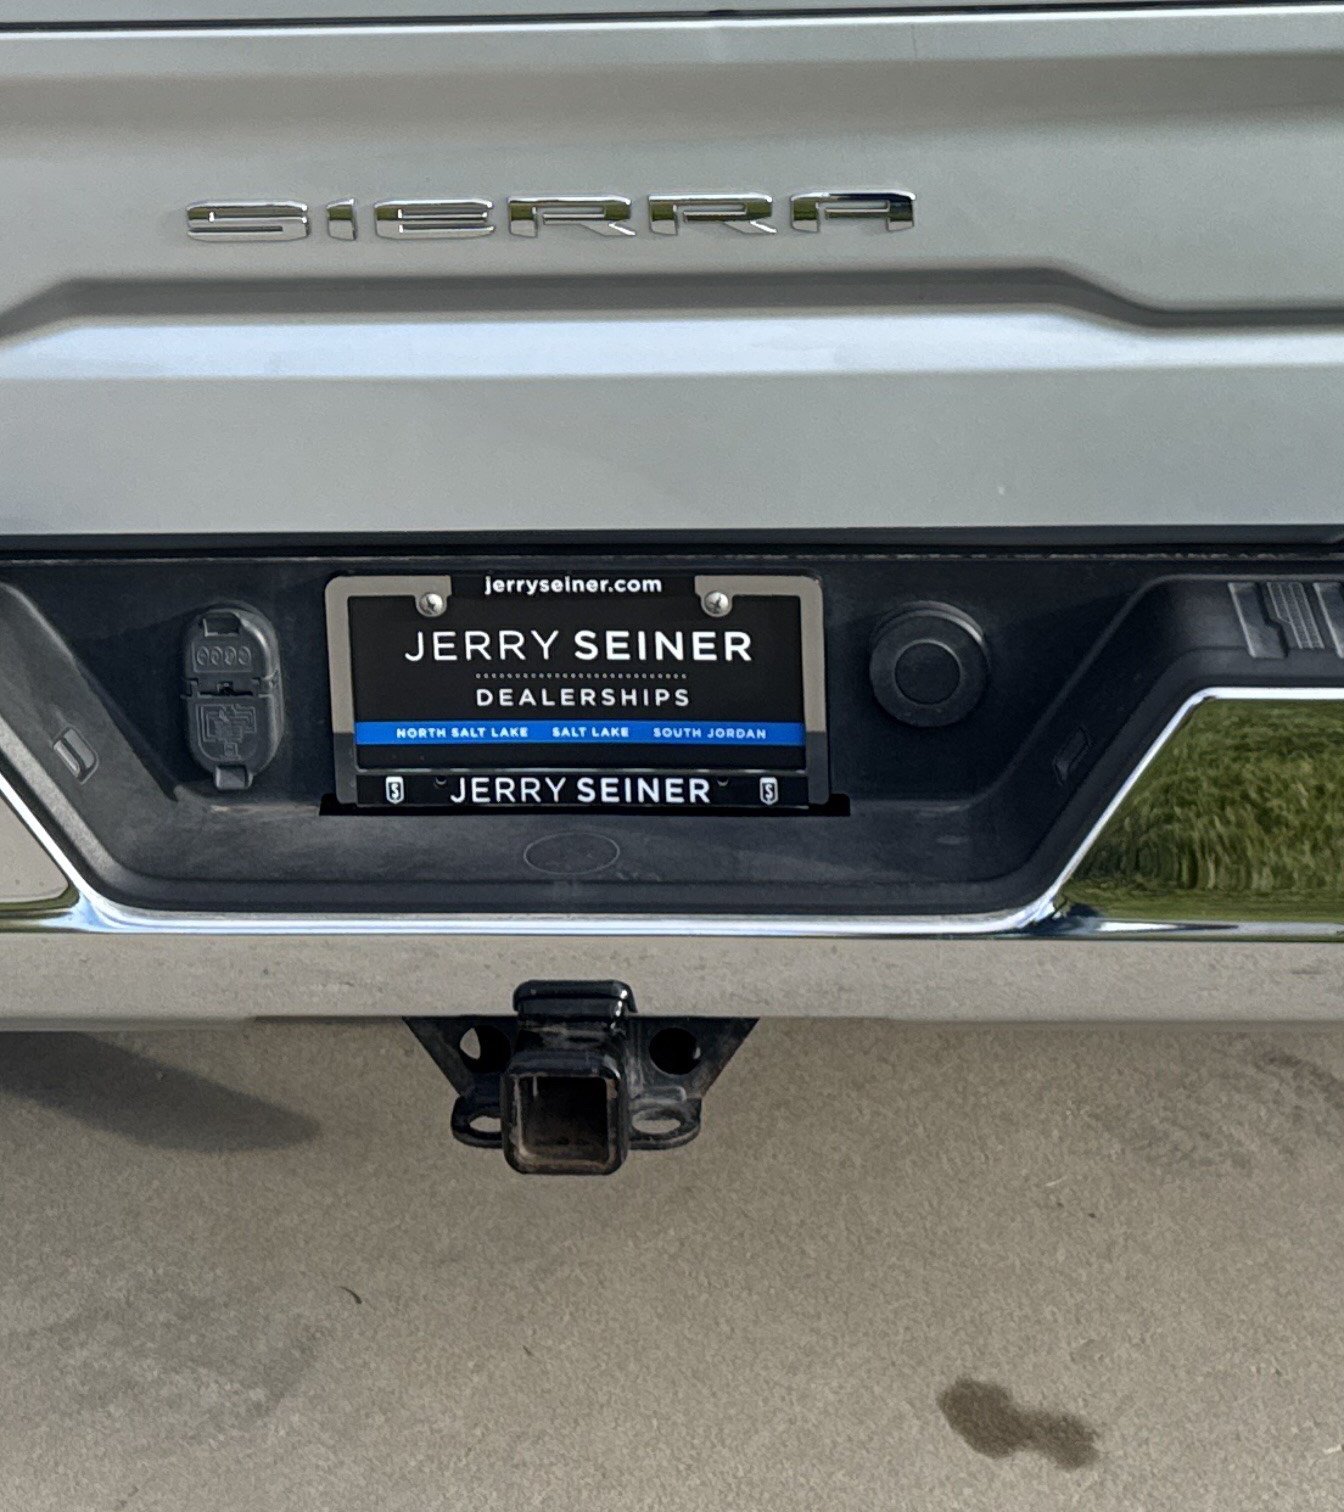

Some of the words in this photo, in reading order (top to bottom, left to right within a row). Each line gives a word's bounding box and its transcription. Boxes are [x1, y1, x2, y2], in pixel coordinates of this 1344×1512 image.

[186, 191, 917, 241] SIERRA
[484, 575, 662, 595] jerryseiner.com
[404, 630, 559, 662] JERRY
[574, 630, 753, 662] SEINER
[476, 688, 689, 707] DEALERSHIPS
[396, 727, 447, 738] NORTH
[451, 727, 486, 738] SALT
[491, 727, 529, 738] LAKE
[552, 727, 586, 738] SALT
[592, 727, 629, 738] LAKE
[653, 727, 702, 739] SOUTH
[707, 728, 767, 739] JORDAN
[450, 777, 566, 803] JERRY
[577, 777, 711, 804] SEINER
